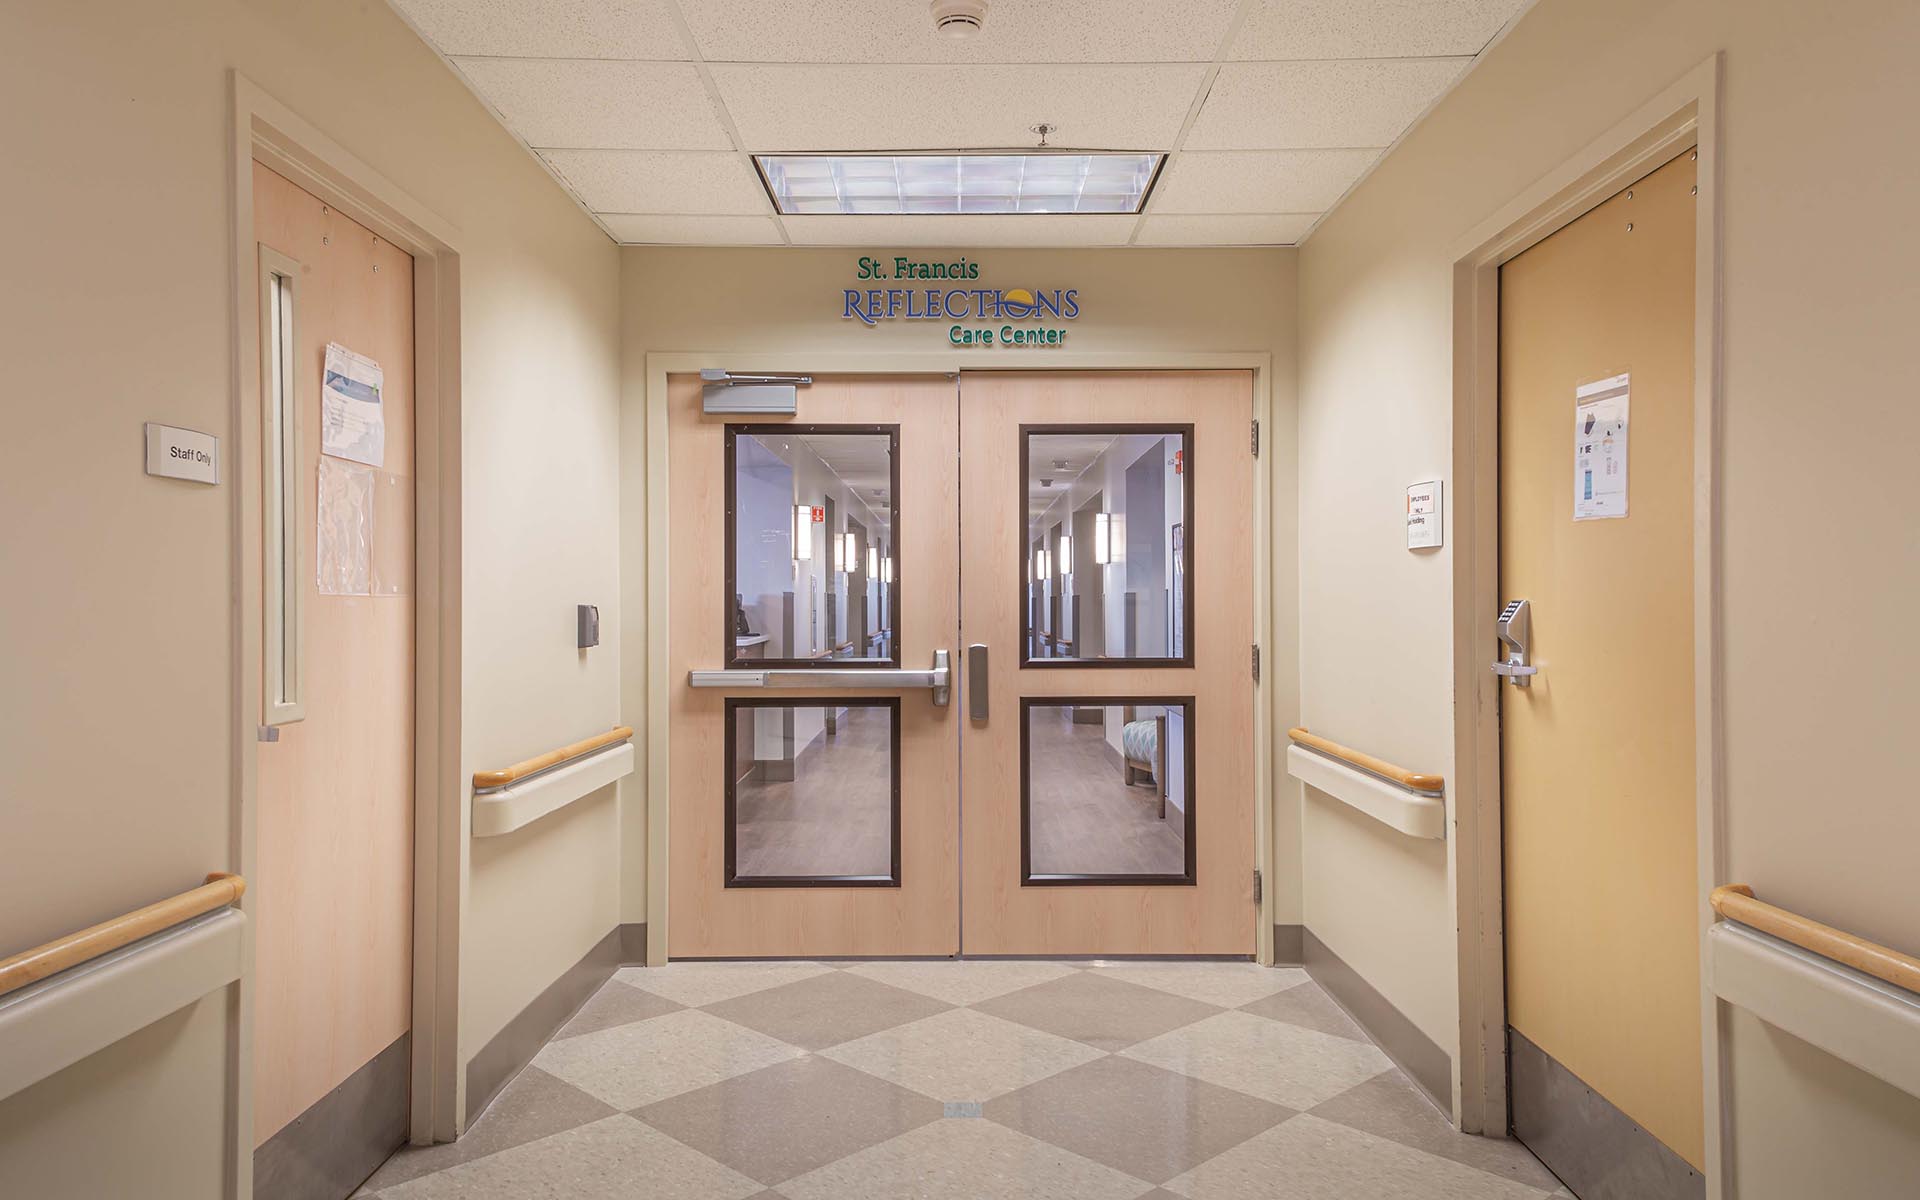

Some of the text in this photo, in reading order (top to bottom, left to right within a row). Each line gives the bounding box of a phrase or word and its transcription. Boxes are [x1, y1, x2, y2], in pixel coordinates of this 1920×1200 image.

[857, 256, 979, 280] St. Francis
[842, 288, 1080, 325] REFLECTIONS
[949, 325, 1067, 344] Care Center
[170, 446, 211, 466] Staff Only
